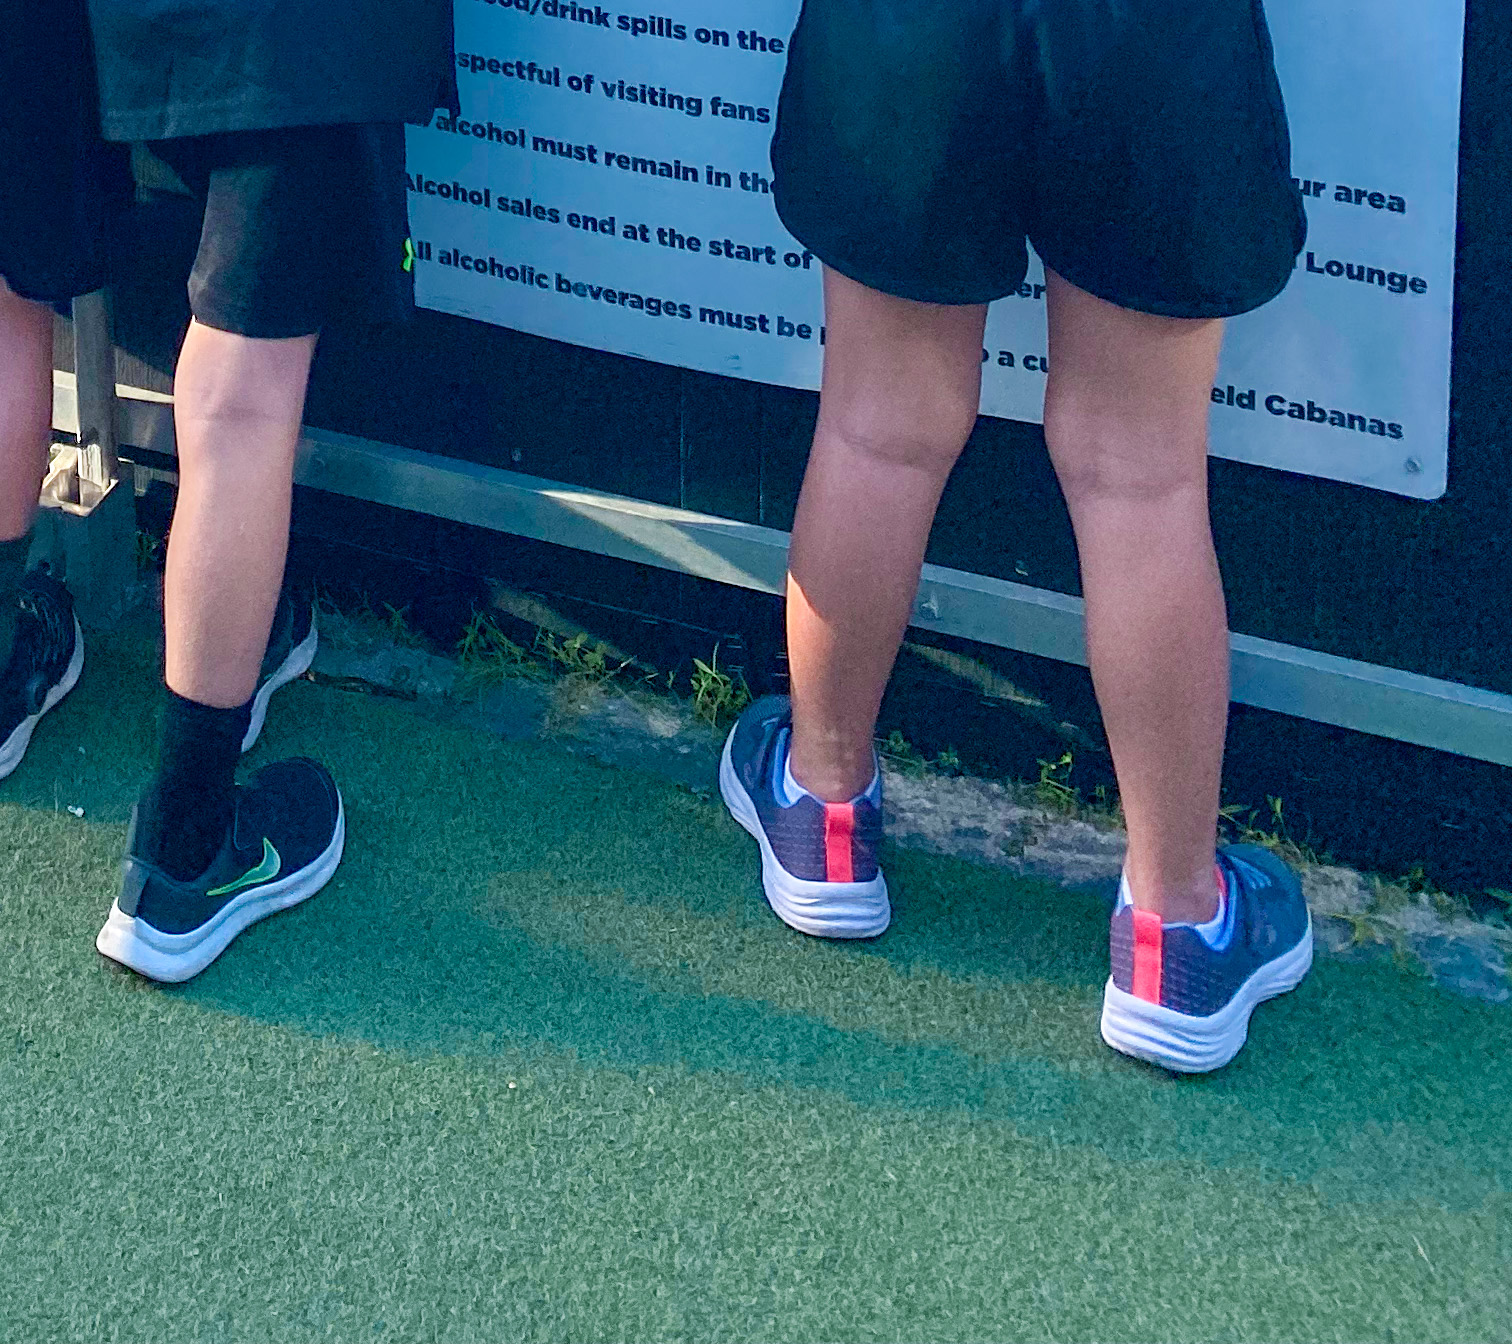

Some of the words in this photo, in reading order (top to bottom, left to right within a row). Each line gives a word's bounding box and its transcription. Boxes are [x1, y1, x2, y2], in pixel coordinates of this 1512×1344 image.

[617, 14, 687, 44] spills
[694, 25, 730, 48] on
[737, 29, 786, 55] the
[567, 74, 594, 95] of
[601, 79, 703, 117] visiting
[710, 96, 771, 124] fans
[532, 133, 597, 164] must
[604, 151, 699, 184] remain
[706, 164, 732, 189] in
[1334, 182, 1406, 215] area
[497, 196, 561, 224] sales
[567, 212, 616, 237] end
[622, 222, 652, 243] at
[657, 226, 702, 253] the
[708, 239, 777, 267] start
[783, 249, 815, 271] of
[1306, 251, 1429, 295] Lounge
[439, 247, 550, 290] alcoholic
[555, 272, 692, 321] beverages
[699, 306, 770, 335] must
[777, 316, 813, 340] be
[998, 350, 1015, 367] a
[1265, 393, 1406, 440] Cabanas
